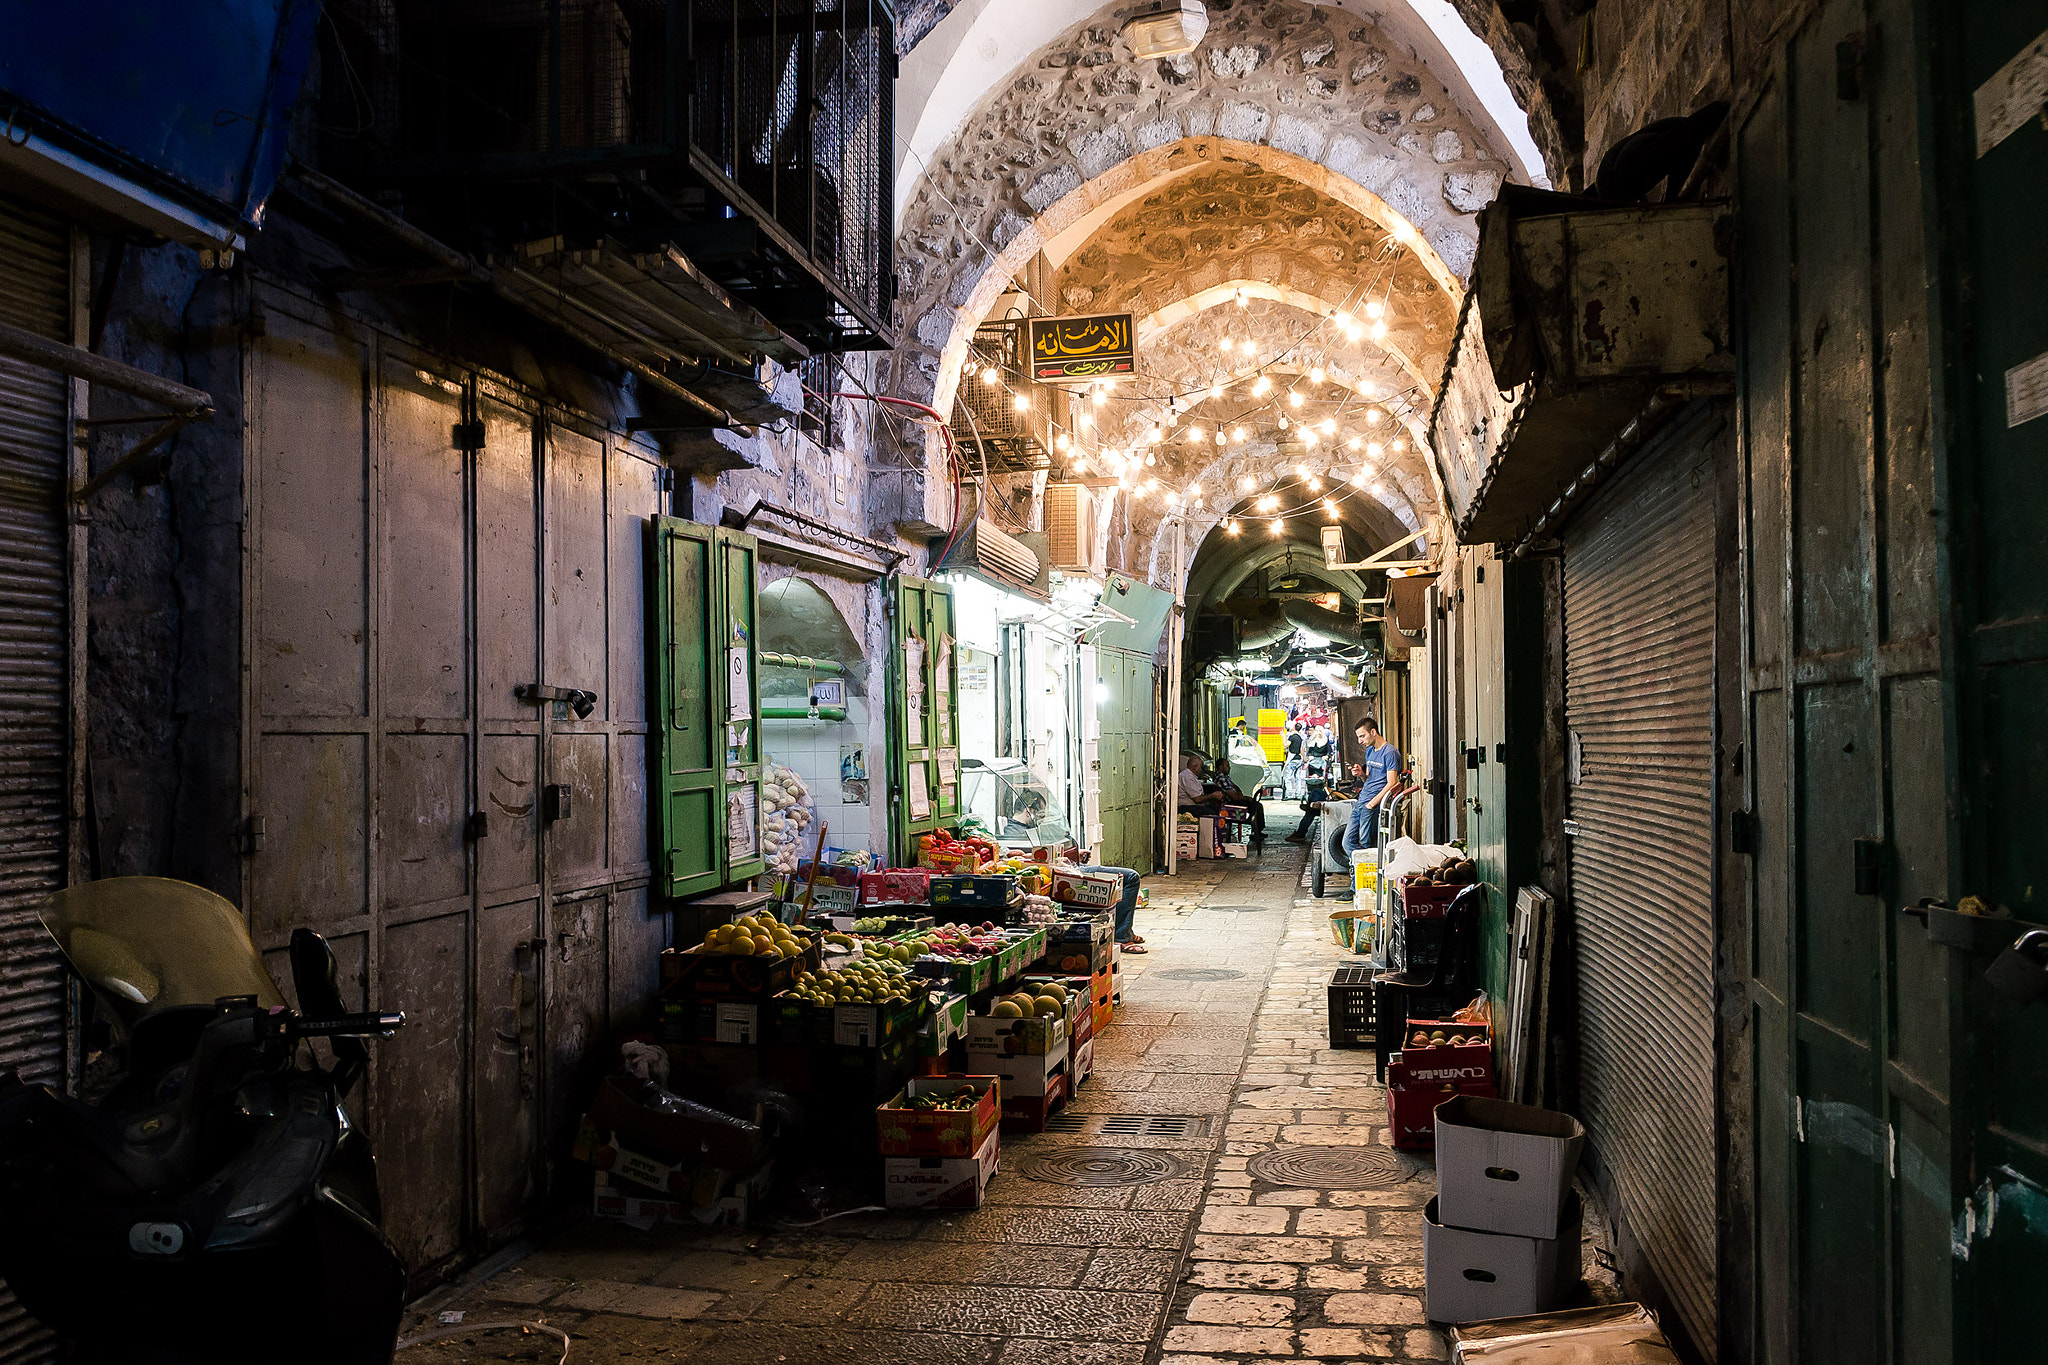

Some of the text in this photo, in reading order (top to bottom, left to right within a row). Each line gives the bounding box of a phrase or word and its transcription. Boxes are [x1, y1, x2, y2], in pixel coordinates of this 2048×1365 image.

[1064, 319, 1099, 340] ملحمة
[831, 890, 852, 900] פירות
[1089, 884, 1108, 896] פירות
